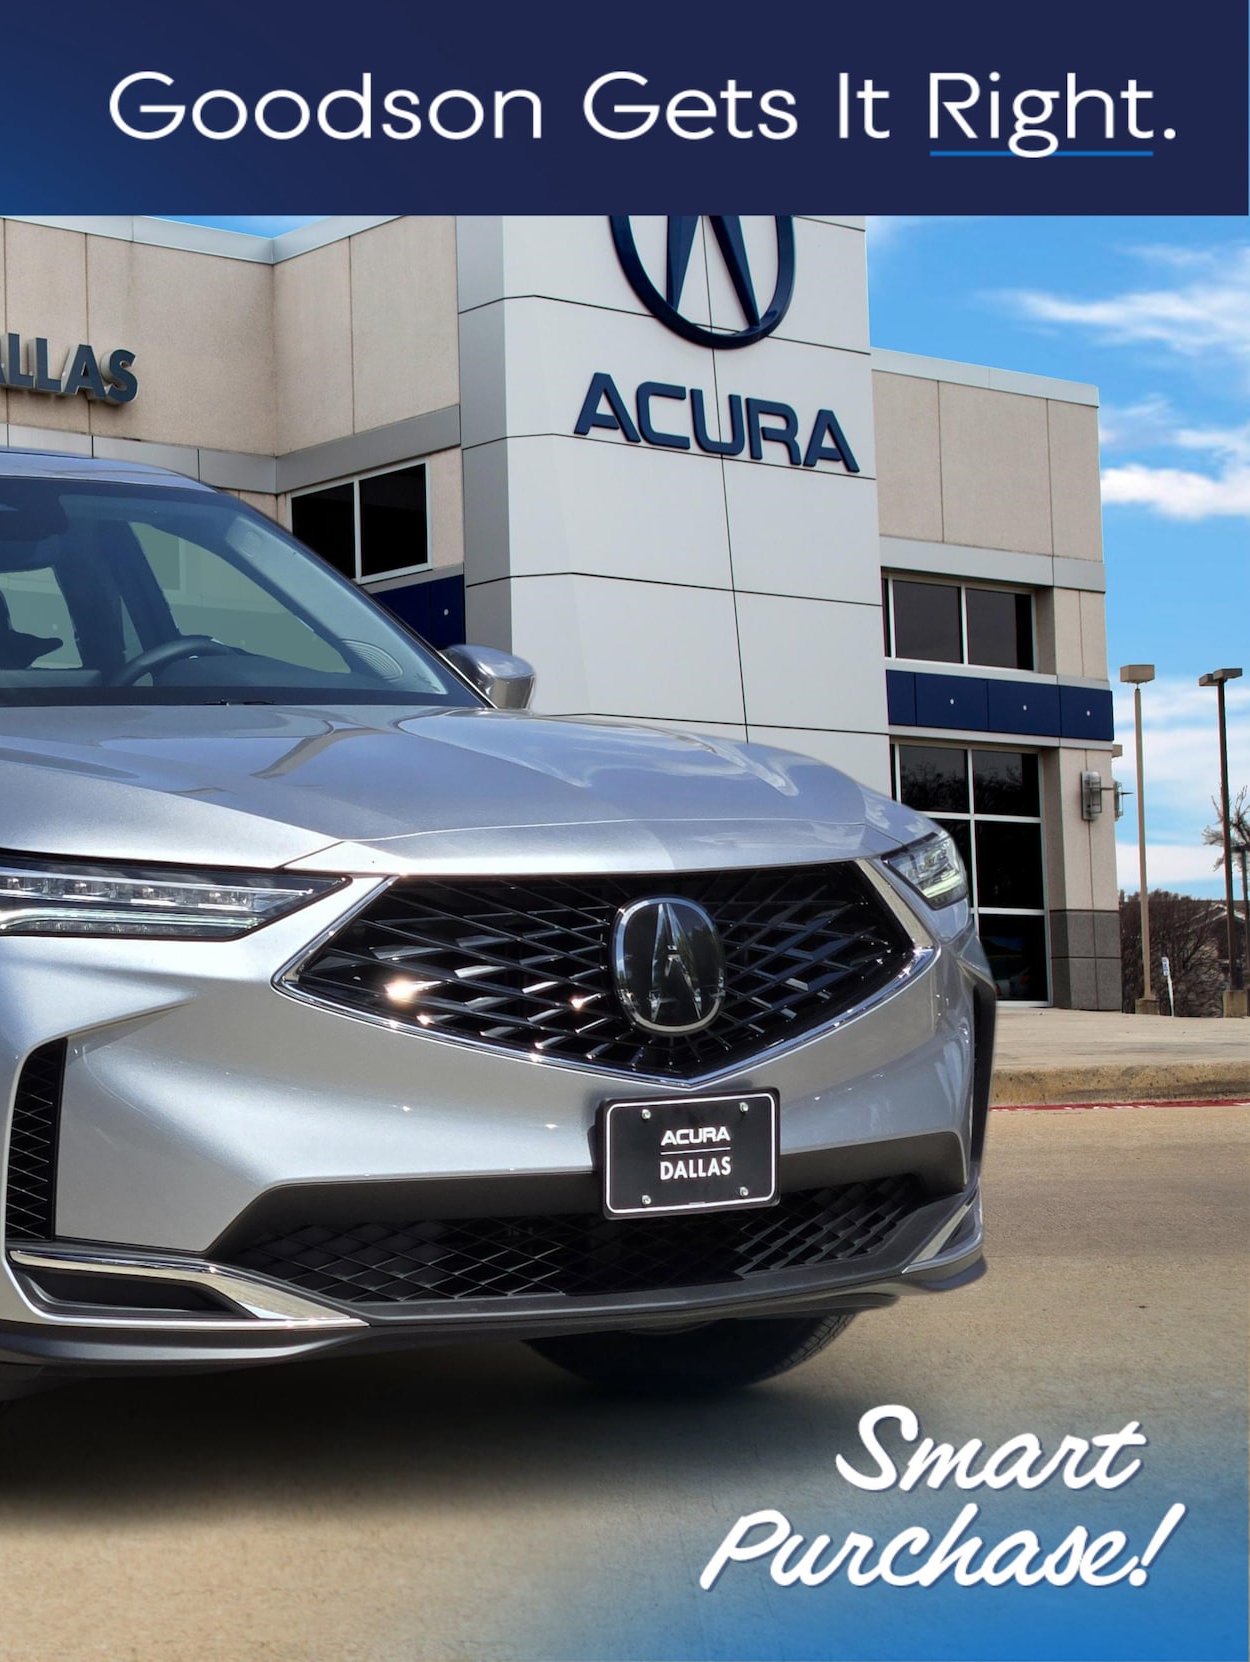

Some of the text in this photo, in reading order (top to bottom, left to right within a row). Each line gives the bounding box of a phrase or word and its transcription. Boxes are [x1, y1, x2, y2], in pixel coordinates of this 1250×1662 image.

[574, 372, 860, 473] ACURA
[661, 1126, 731, 1146] ACURA
[659, 1156, 732, 1181] DALLAS
